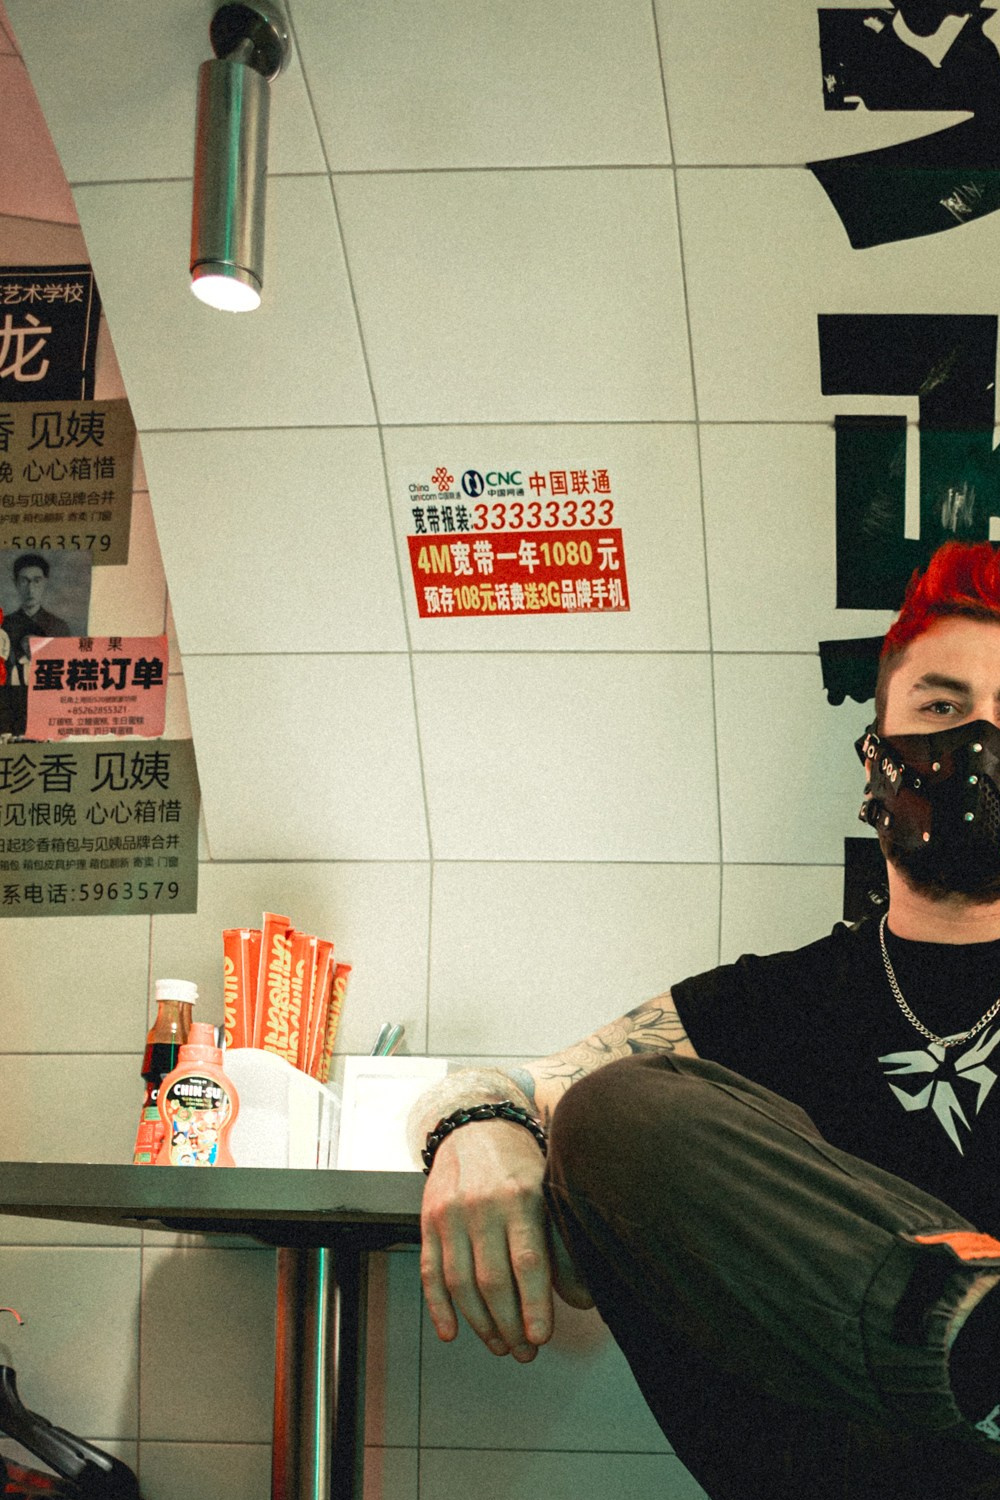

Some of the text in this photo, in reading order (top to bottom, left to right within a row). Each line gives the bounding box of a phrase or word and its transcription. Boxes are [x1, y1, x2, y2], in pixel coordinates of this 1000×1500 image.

[0, 283, 84, 304] 艺术学校
[28, 410, 106, 450] 见姨
[23, 456, 115, 482] 心心箱惜
[486, 471, 522, 486] CNC
[529, 470, 612, 496] 中国联通
[0, 491, 115, 508] 包与见姨品牌合并
[424, 578, 625, 613] 预存108元话费送3G品牌手机
[33, 657, 163, 690] 蛋糕订单
[91, 751, 170, 792] 见姨
[0, 800, 181, 826] 见恨晚 心心箱惜
[174, 1084, 220, 1098] CHIN-SU
